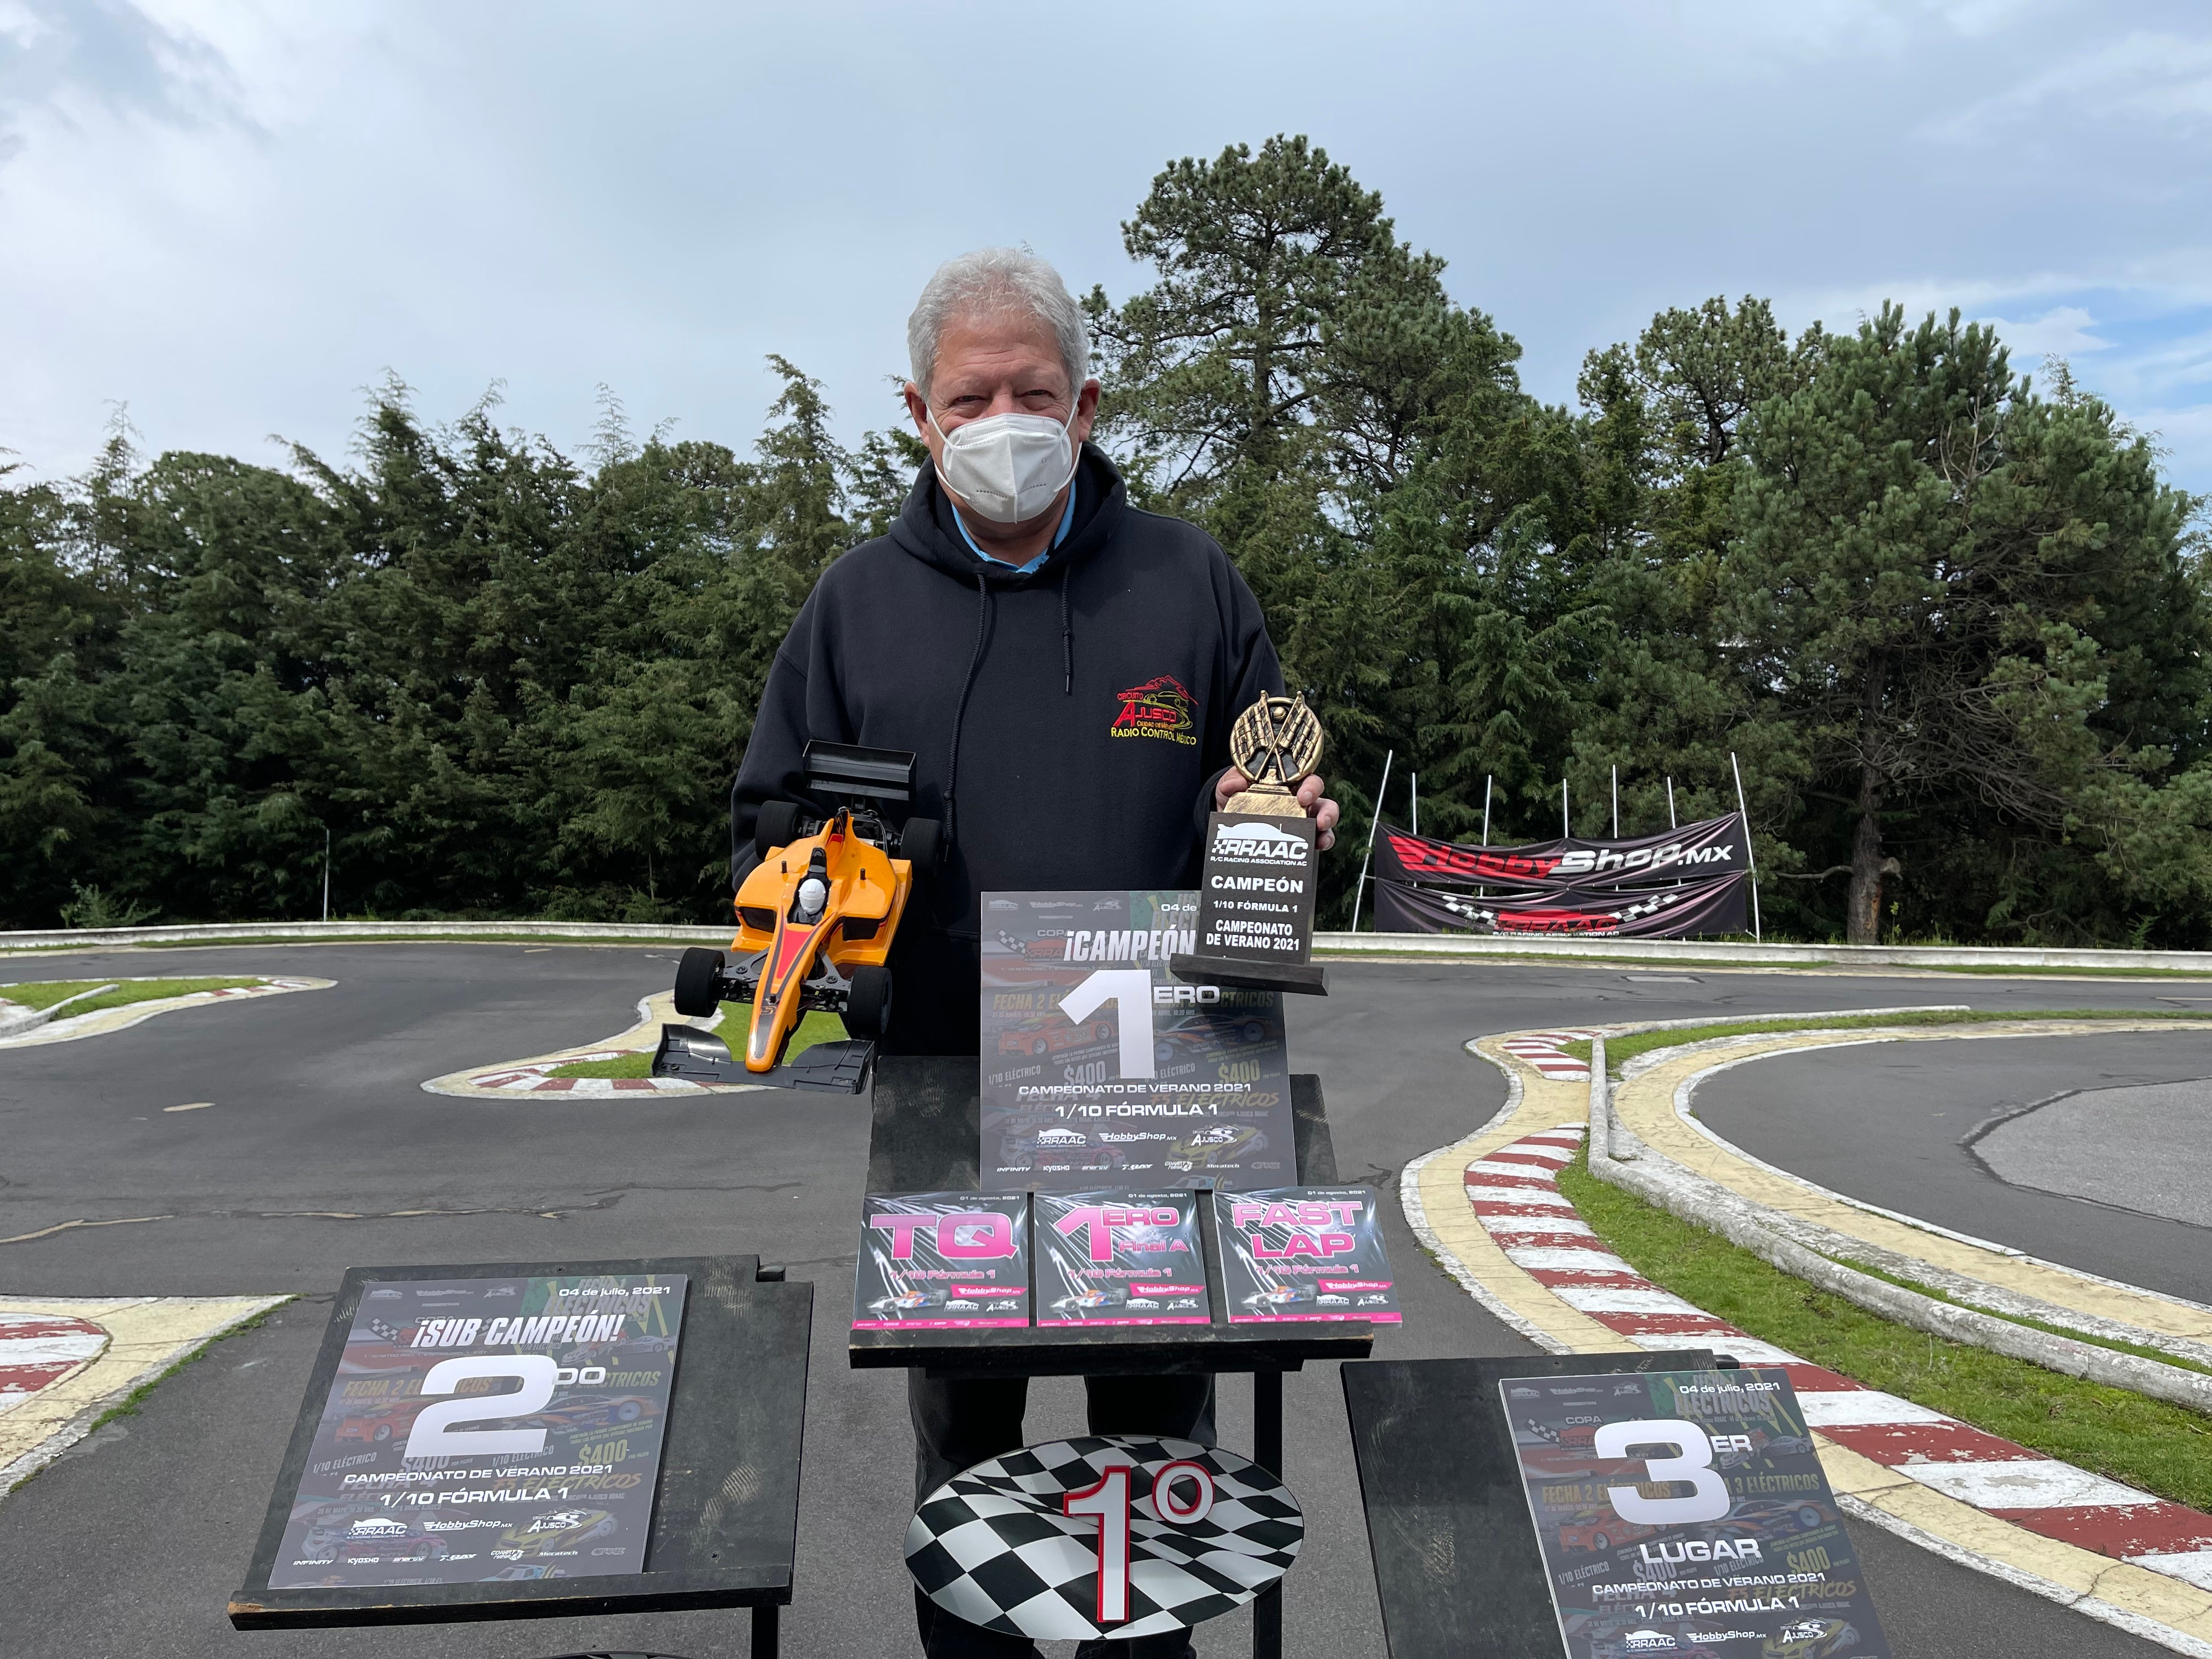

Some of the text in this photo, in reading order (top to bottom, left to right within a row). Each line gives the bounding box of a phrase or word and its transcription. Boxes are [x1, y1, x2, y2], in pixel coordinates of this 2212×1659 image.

[1113, 701, 1176, 727] AJUSCO
[1111, 727, 1139, 737] RADIO
[1141, 726, 1175, 741] CONTROL
[1223, 839, 1308, 860] RRAAC
[1211, 876, 1303, 893] CAMPEÓN
[1214, 900, 1234, 909] 1/10
[1237, 900, 1289, 912] FÓRMULA
[1216, 919, 1293, 936] CAMPEONATO
[1206, 933, 1300, 951] DE VERANO 2021
[993, 994, 1032, 1010] FECHA
[1036, 994, 1046, 1009] 2
[988, 1064, 1041, 1085] 1/10 ELÉCTRICO
[1064, 1060, 1106, 1086] $400
[1160, 1063, 1195, 1077] ELÉCTRICO
[1218, 1059, 1260, 1084] $400
[1019, 1084, 1251, 1095] CAMPEONATO DE VERANO 2021
[1055, 1104, 1102, 1119] 1/10
[1105, 1101, 1204, 1116] FÓRMULA
[1208, 1104, 1218, 1115] 1
[1191, 1134, 1223, 1146] AJUSCO
[1231, 1201, 1363, 1228] FAST
[870, 1212, 1019, 1260] TQ
[1118, 1239, 1189, 1252] Final A
[1250, 1233, 1356, 1259] LAP
[889, 1268, 996, 1280] 1/10 Fórmula 1
[1067, 1267, 1172, 1279] 1/10 Fórmula 1
[1255, 1263, 1359, 1275] 1/10 Fórmula 1
[600, 1287, 629, 1297] julio,
[632, 1286, 670, 1295] 2021
[410, 1310, 625, 1348] ¡SUB CAMPEÓN!
[343, 1380, 390, 1397] FECHA
[391, 1379, 405, 1396] 2
[1679, 1382, 1781, 1394] 04 de julio, 2021
[1674, 1389, 1772, 1415] ELECTRICOS
[1565, 1415, 1603, 1425] COPA
[578, 1440, 628, 1466] $400
[313, 1452, 377, 1474] 1/10 ELÉCTRICO
[344, 1465, 612, 1483] CAMPEONATO DE VERANO 2021
[1735, 1471, 1820, 1493] 3 ELÉCTRICOS
[380, 1491, 434, 1508] 1/10
[437, 1487, 551, 1504] FÓRMULA
[557, 1487, 568, 1499] 1
[1542, 1485, 1582, 1504] FECHA
[1585, 1485, 1593, 1502] 2
[356, 1525, 408, 1535] RRAAC
[527, 1520, 566, 1533] AJUSCO
[1639, 1538, 1762, 1564] LUGAR
[1787, 1546, 1830, 1574] $400
[347, 1557, 379, 1565] KYOSHO
[1558, 1561, 1610, 1585] 1/10 ELÉCTRICO
[1592, 1572, 1825, 1595] CAMPEONATO DE VERANO 2021
[1635, 1596, 1799, 1620] 1/10 FÓRMULA 1
[1632, 1638, 1675, 1648] RRAAC
[1782, 1630, 1814, 1643] AJUSCO
